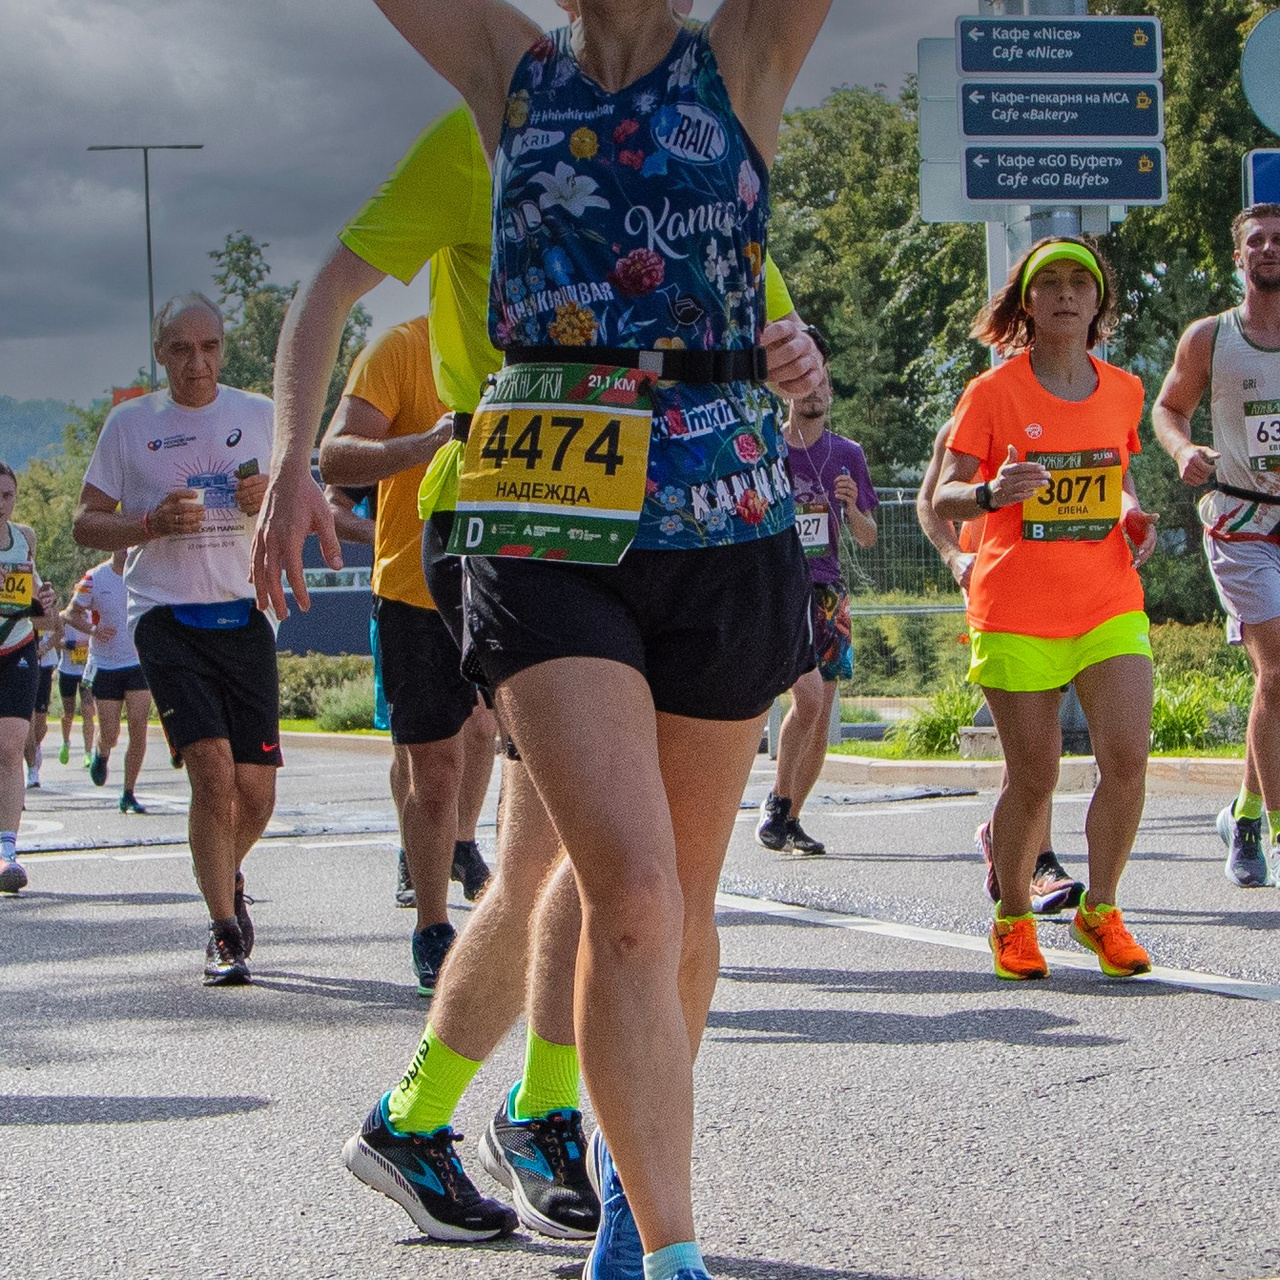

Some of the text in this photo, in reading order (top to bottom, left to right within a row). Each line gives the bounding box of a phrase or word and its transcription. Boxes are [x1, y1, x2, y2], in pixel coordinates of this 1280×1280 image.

[992, 27, 1081, 41] Кафе «Nice»
[993, 45, 1073, 61] Cafe «Nice»
[991, 91, 1130, 106] Кафе-пекарня на МСА
[991, 108, 1078, 122] Cafe «Bakery»
[664, 114, 717, 160] RAIL
[997, 154, 1122, 170] Кафе «GO Буфет»
[997, 173, 1109, 189] Cafe «GO Bufet»
[614, 378, 636, 392] КМ
[481, 414, 624, 476] 4474
[495, 481, 592, 505] НАДЕЖДА
[1037, 474, 1107, 506] 3071
[1057, 505, 1090, 516] ЕЛЕНА
[465, 517, 484, 548] D
[400, 1039, 430, 1093] GIRO
